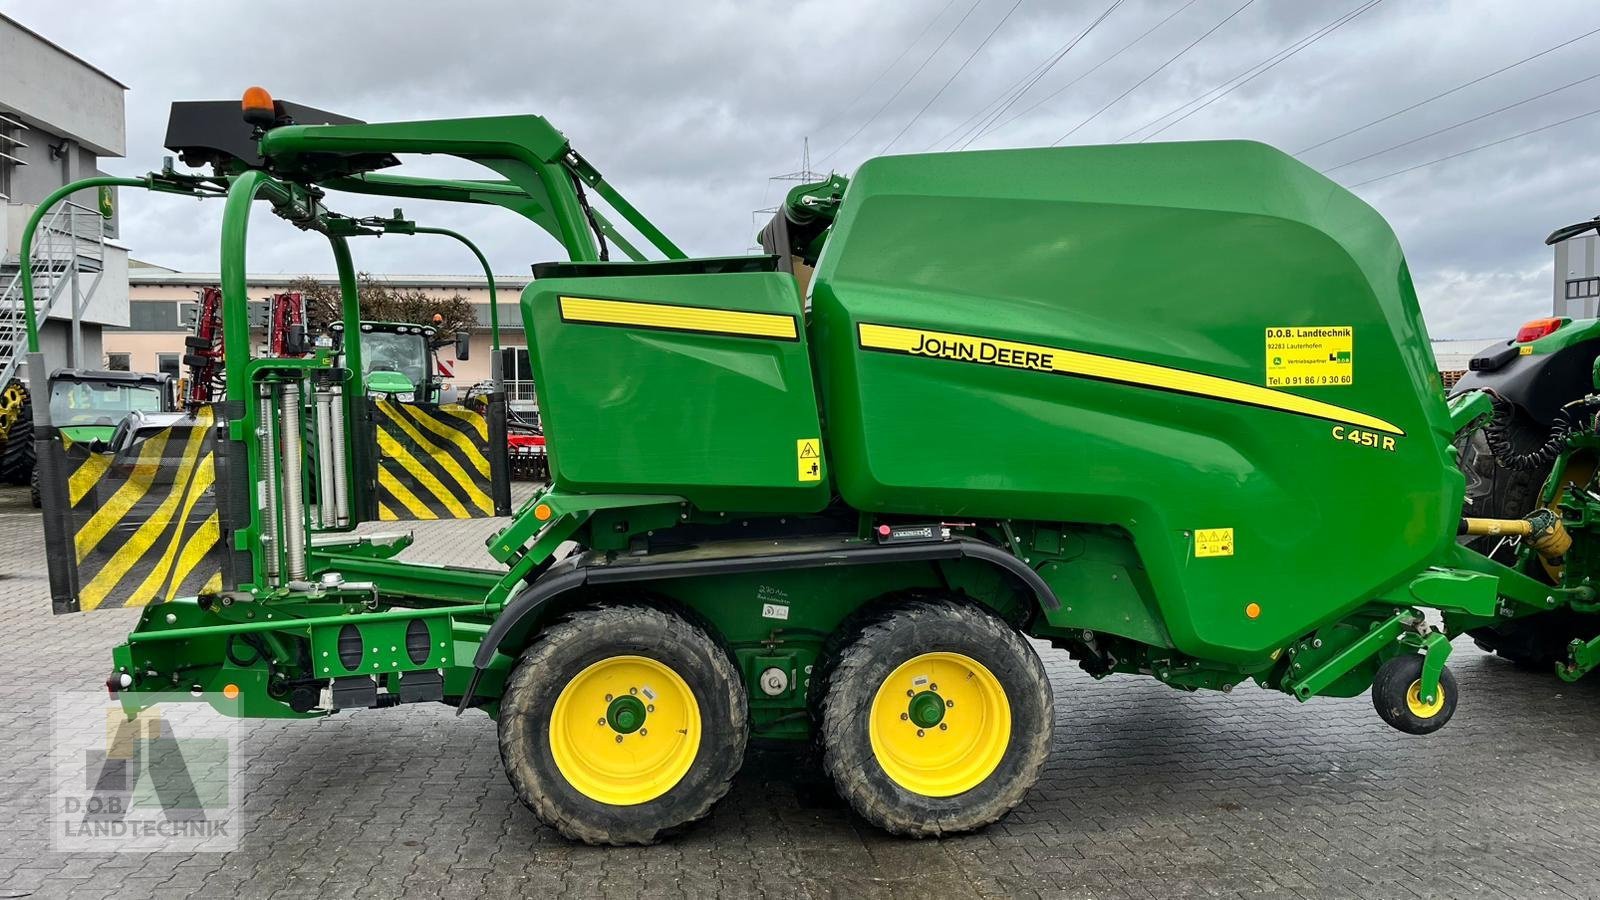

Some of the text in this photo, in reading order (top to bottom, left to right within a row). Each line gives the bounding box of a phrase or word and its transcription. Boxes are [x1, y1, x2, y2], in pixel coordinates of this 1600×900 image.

[1267, 328, 1351, 338] D.O.B. Landtechnik
[911, 334, 1054, 369] JOHN DEERE
[1268, 377, 1283, 385] Tel.
[1292, 376, 1302, 384] 91
[1304, 376, 1315, 384] 86
[1321, 376, 1327, 384] 9
[1329, 375, 1339, 383] 30
[1341, 375, 1351, 383] 60
[1332, 426, 1396, 451] C 451 R
